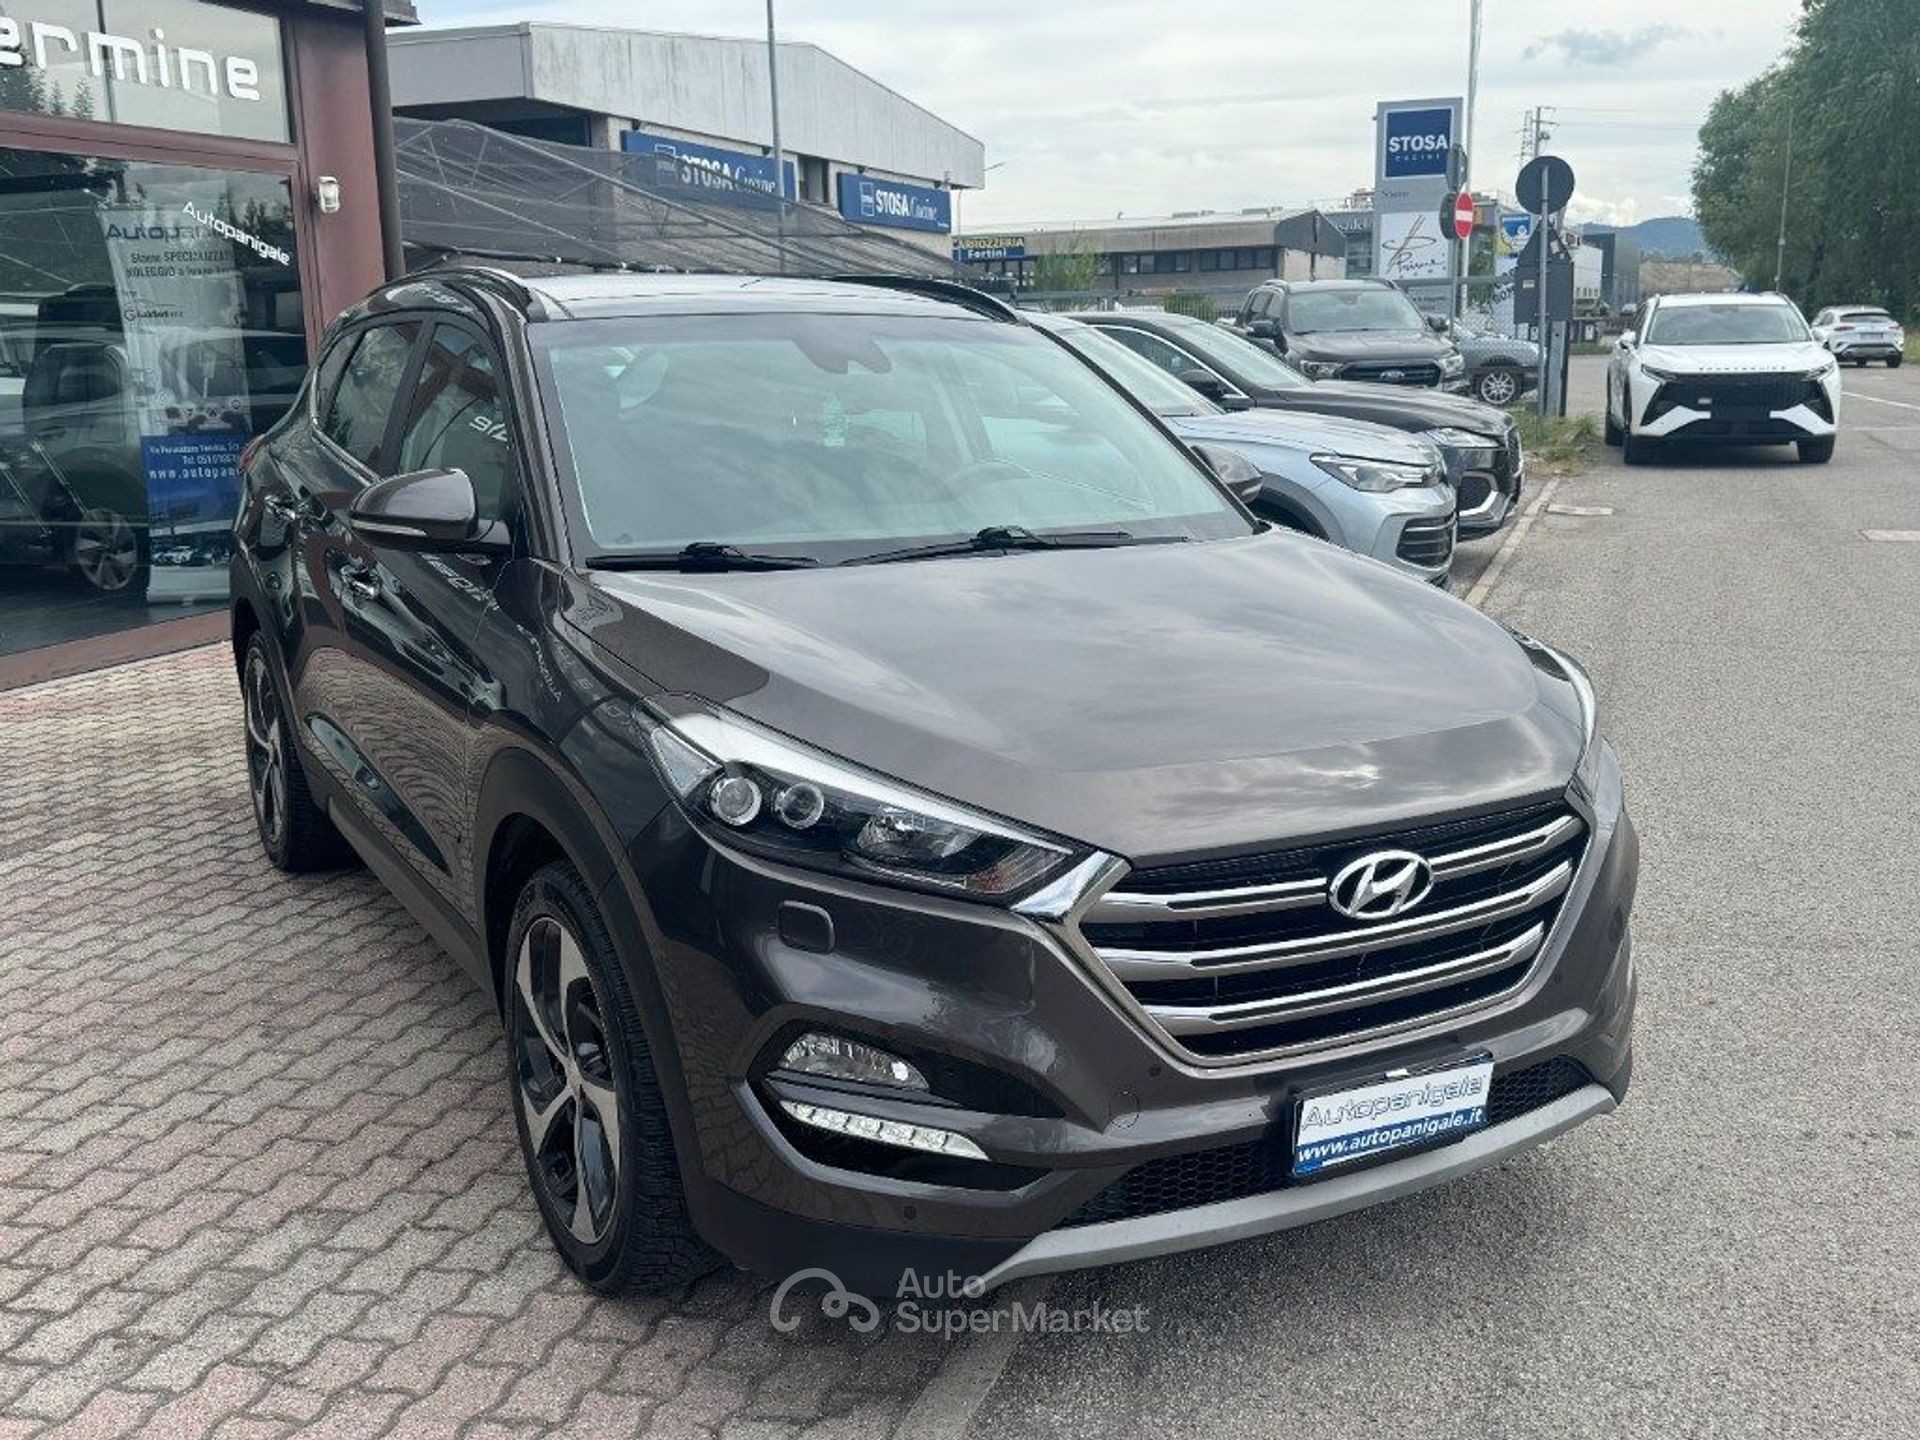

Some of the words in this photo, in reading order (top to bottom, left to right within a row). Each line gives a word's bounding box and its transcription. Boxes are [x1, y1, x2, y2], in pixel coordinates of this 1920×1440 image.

[1388, 134, 1449, 153] STOSA
[681, 154, 734, 190] STOSA
[876, 189, 911, 218] STOSA
[182, 200, 291, 266] Autopanigale
[967, 249, 1006, 260] Fortini
[1301, 1075, 1484, 1132] Autopanigale
[1298, 1108, 1483, 1163] www.autopanigale.it
